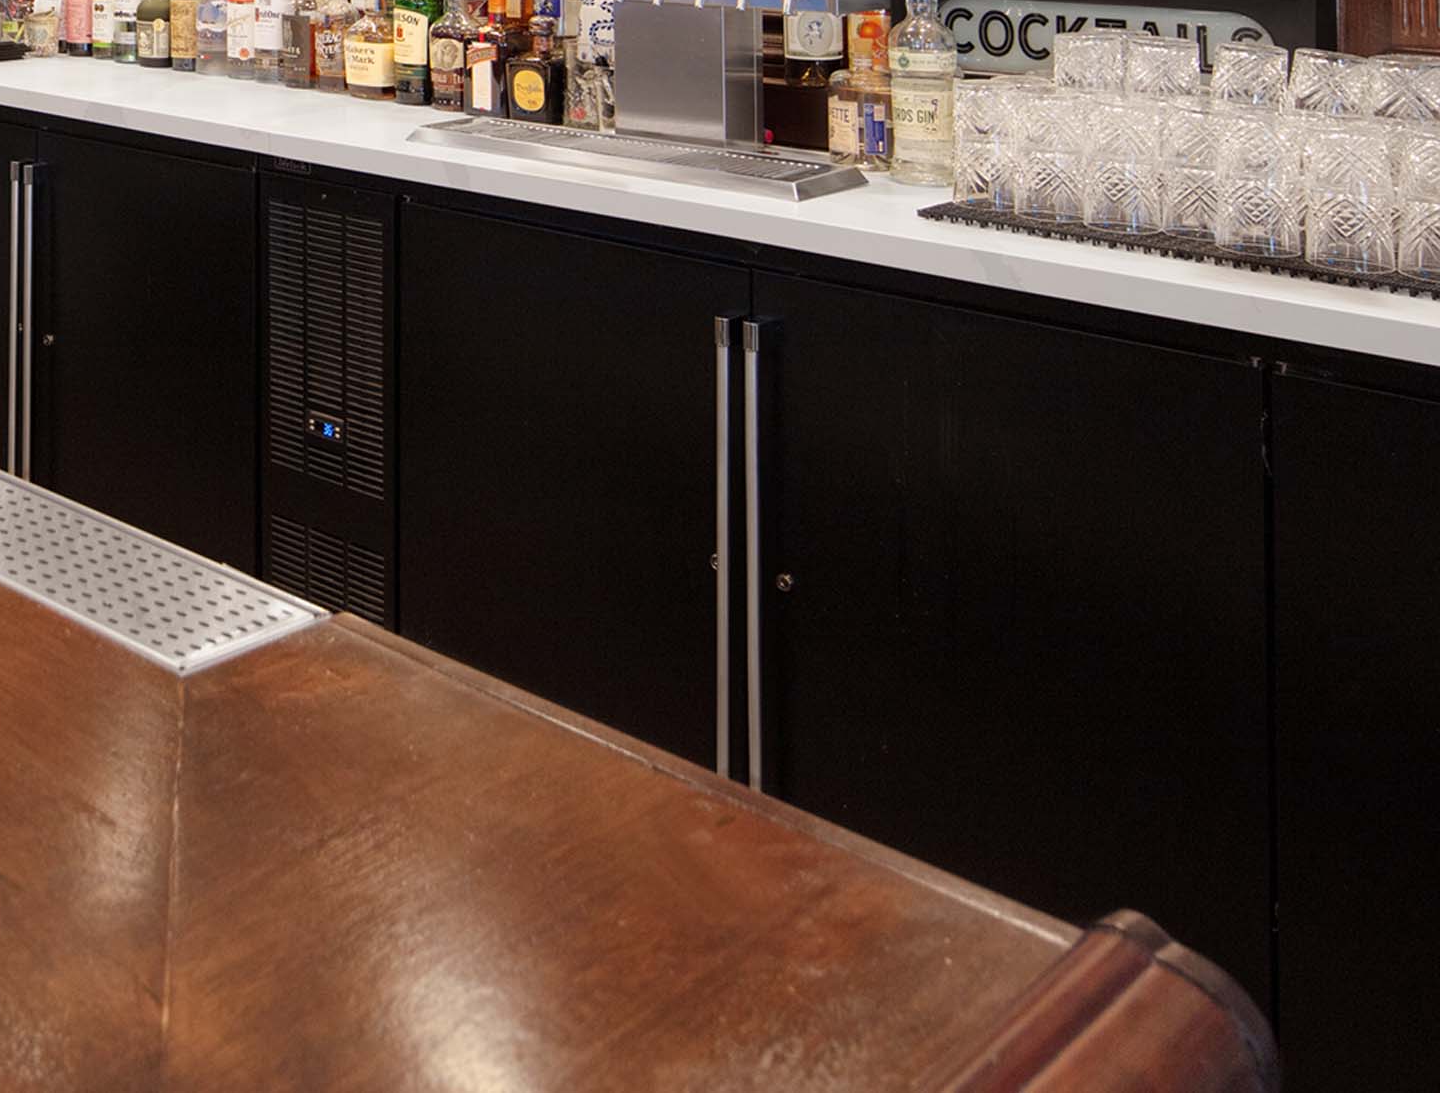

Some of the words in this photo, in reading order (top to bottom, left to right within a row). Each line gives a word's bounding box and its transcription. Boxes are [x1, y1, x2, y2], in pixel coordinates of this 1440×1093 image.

[832, 108, 849, 123] ETTE
[895, 109, 913, 123] RDS
[917, 110, 934, 124] GIN
